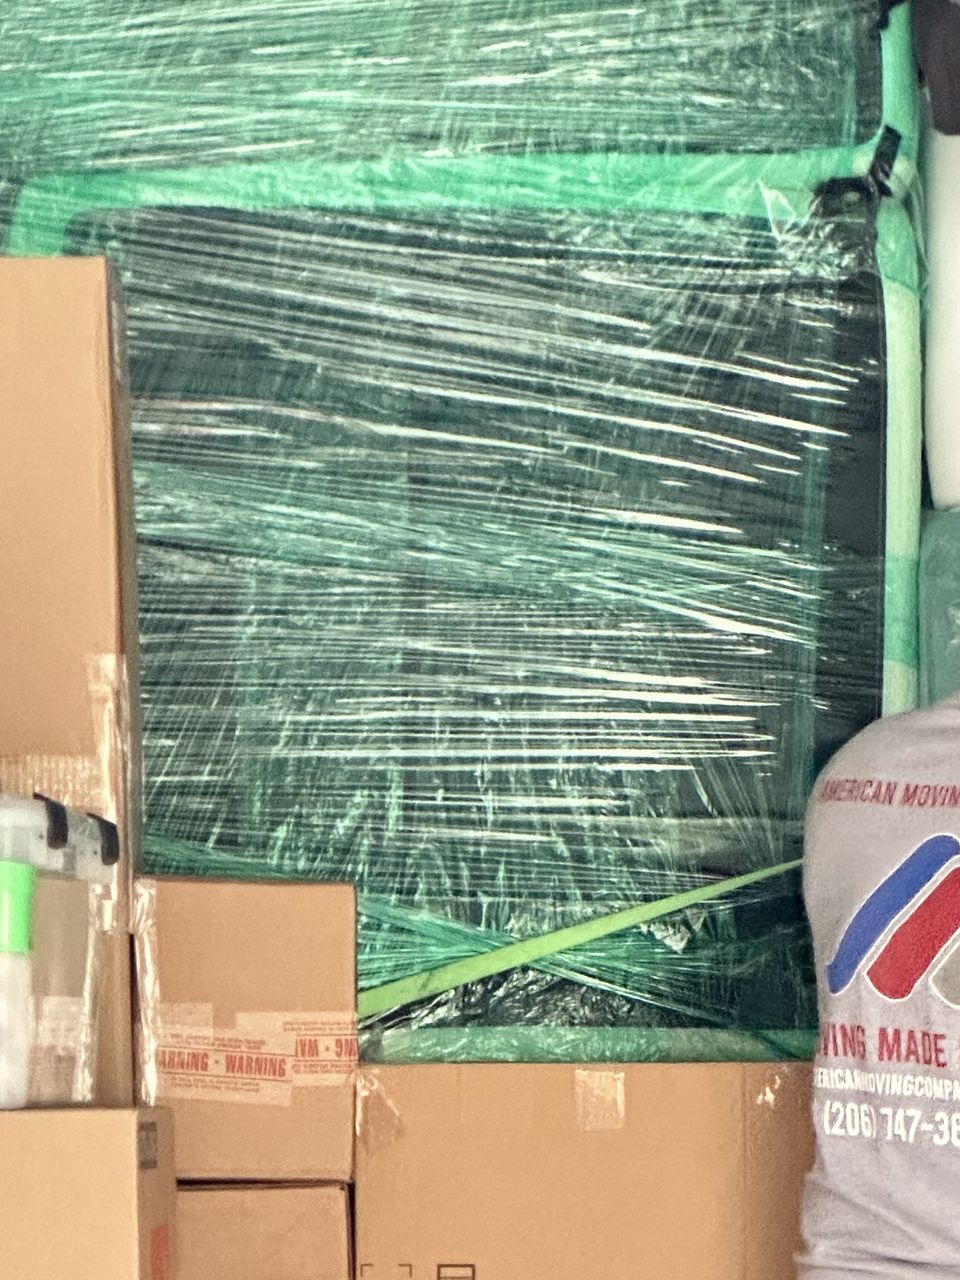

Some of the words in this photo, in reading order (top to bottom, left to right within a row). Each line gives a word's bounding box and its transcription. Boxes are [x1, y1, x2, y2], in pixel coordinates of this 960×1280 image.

[225, 1053, 287, 1078] WARNING
[878, 1027, 947, 1068] MADE
[823, 1099, 877, 1138] (206)
